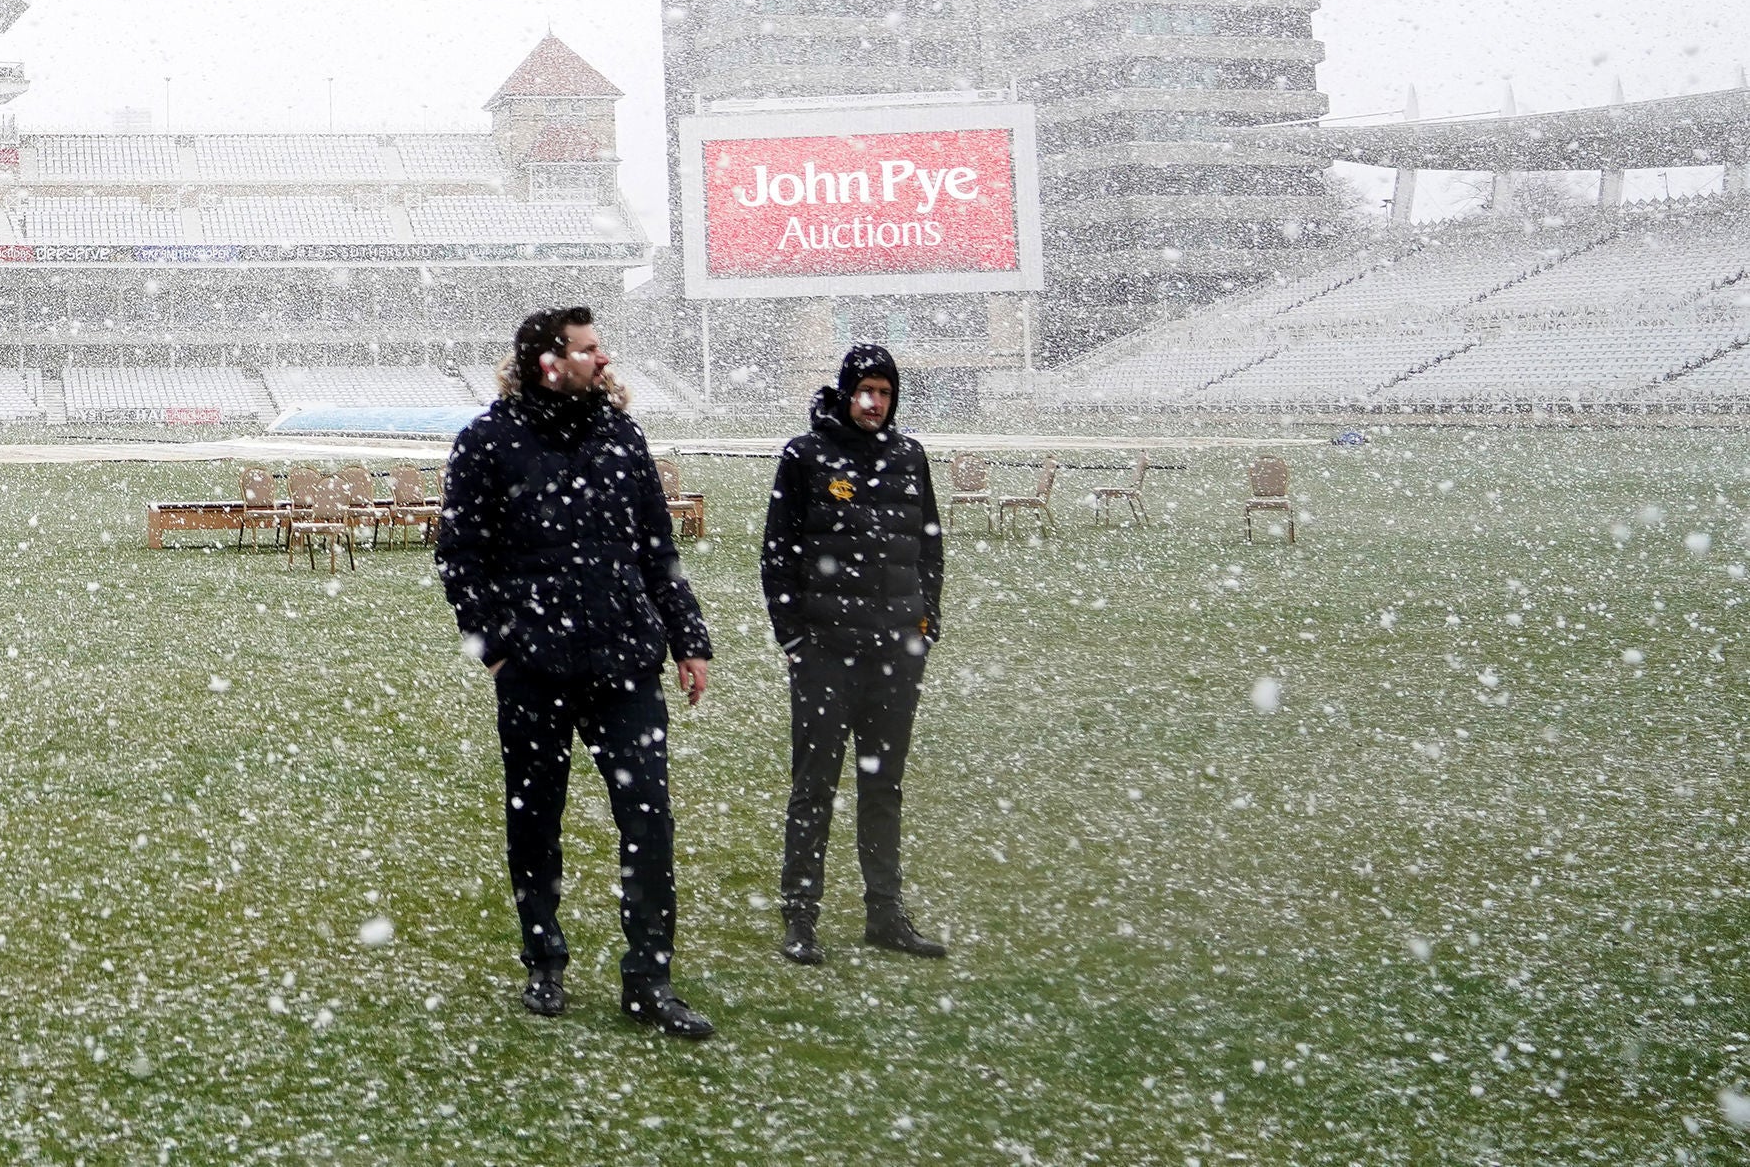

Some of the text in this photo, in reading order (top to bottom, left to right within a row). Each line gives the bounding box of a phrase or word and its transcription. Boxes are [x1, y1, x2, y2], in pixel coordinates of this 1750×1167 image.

[738, 159, 980, 213] John Pye
[777, 216, 942, 250] Auctions
